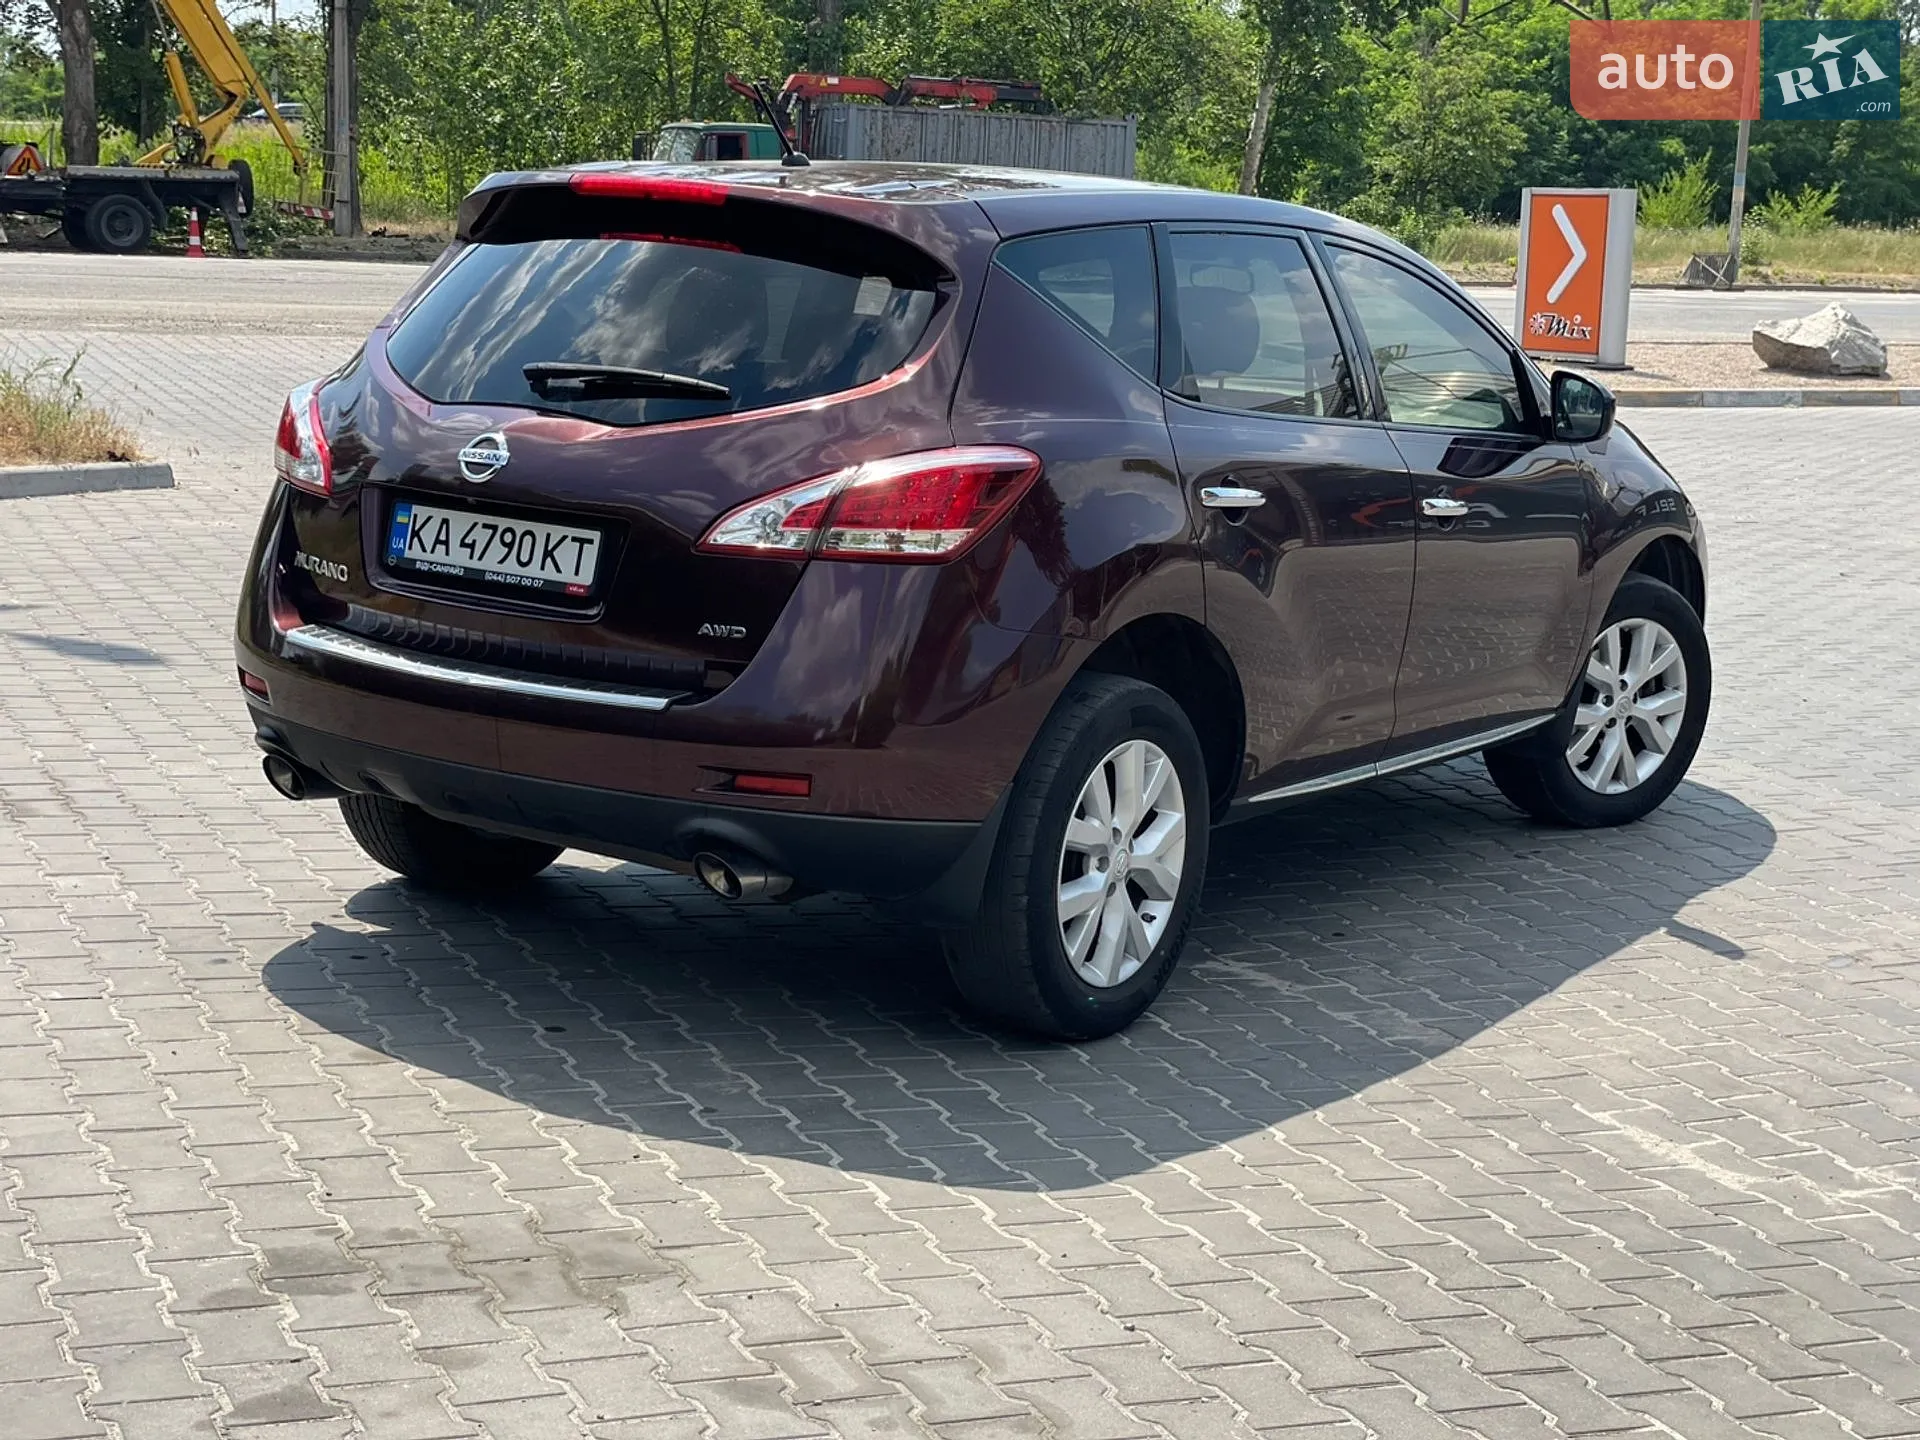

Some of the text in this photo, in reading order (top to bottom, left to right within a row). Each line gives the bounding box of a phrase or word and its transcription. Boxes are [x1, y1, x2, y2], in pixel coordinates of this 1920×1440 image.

[1540, 312, 1592, 340] Mix
[463, 450, 501, 463] NISSAN
[391, 536, 405, 550] UA
[408, 513, 594, 577] KA 4790 KT
[294, 550, 348, 582] MURANO
[506, 574, 521, 584] 507
[697, 622, 747, 639] AWD
